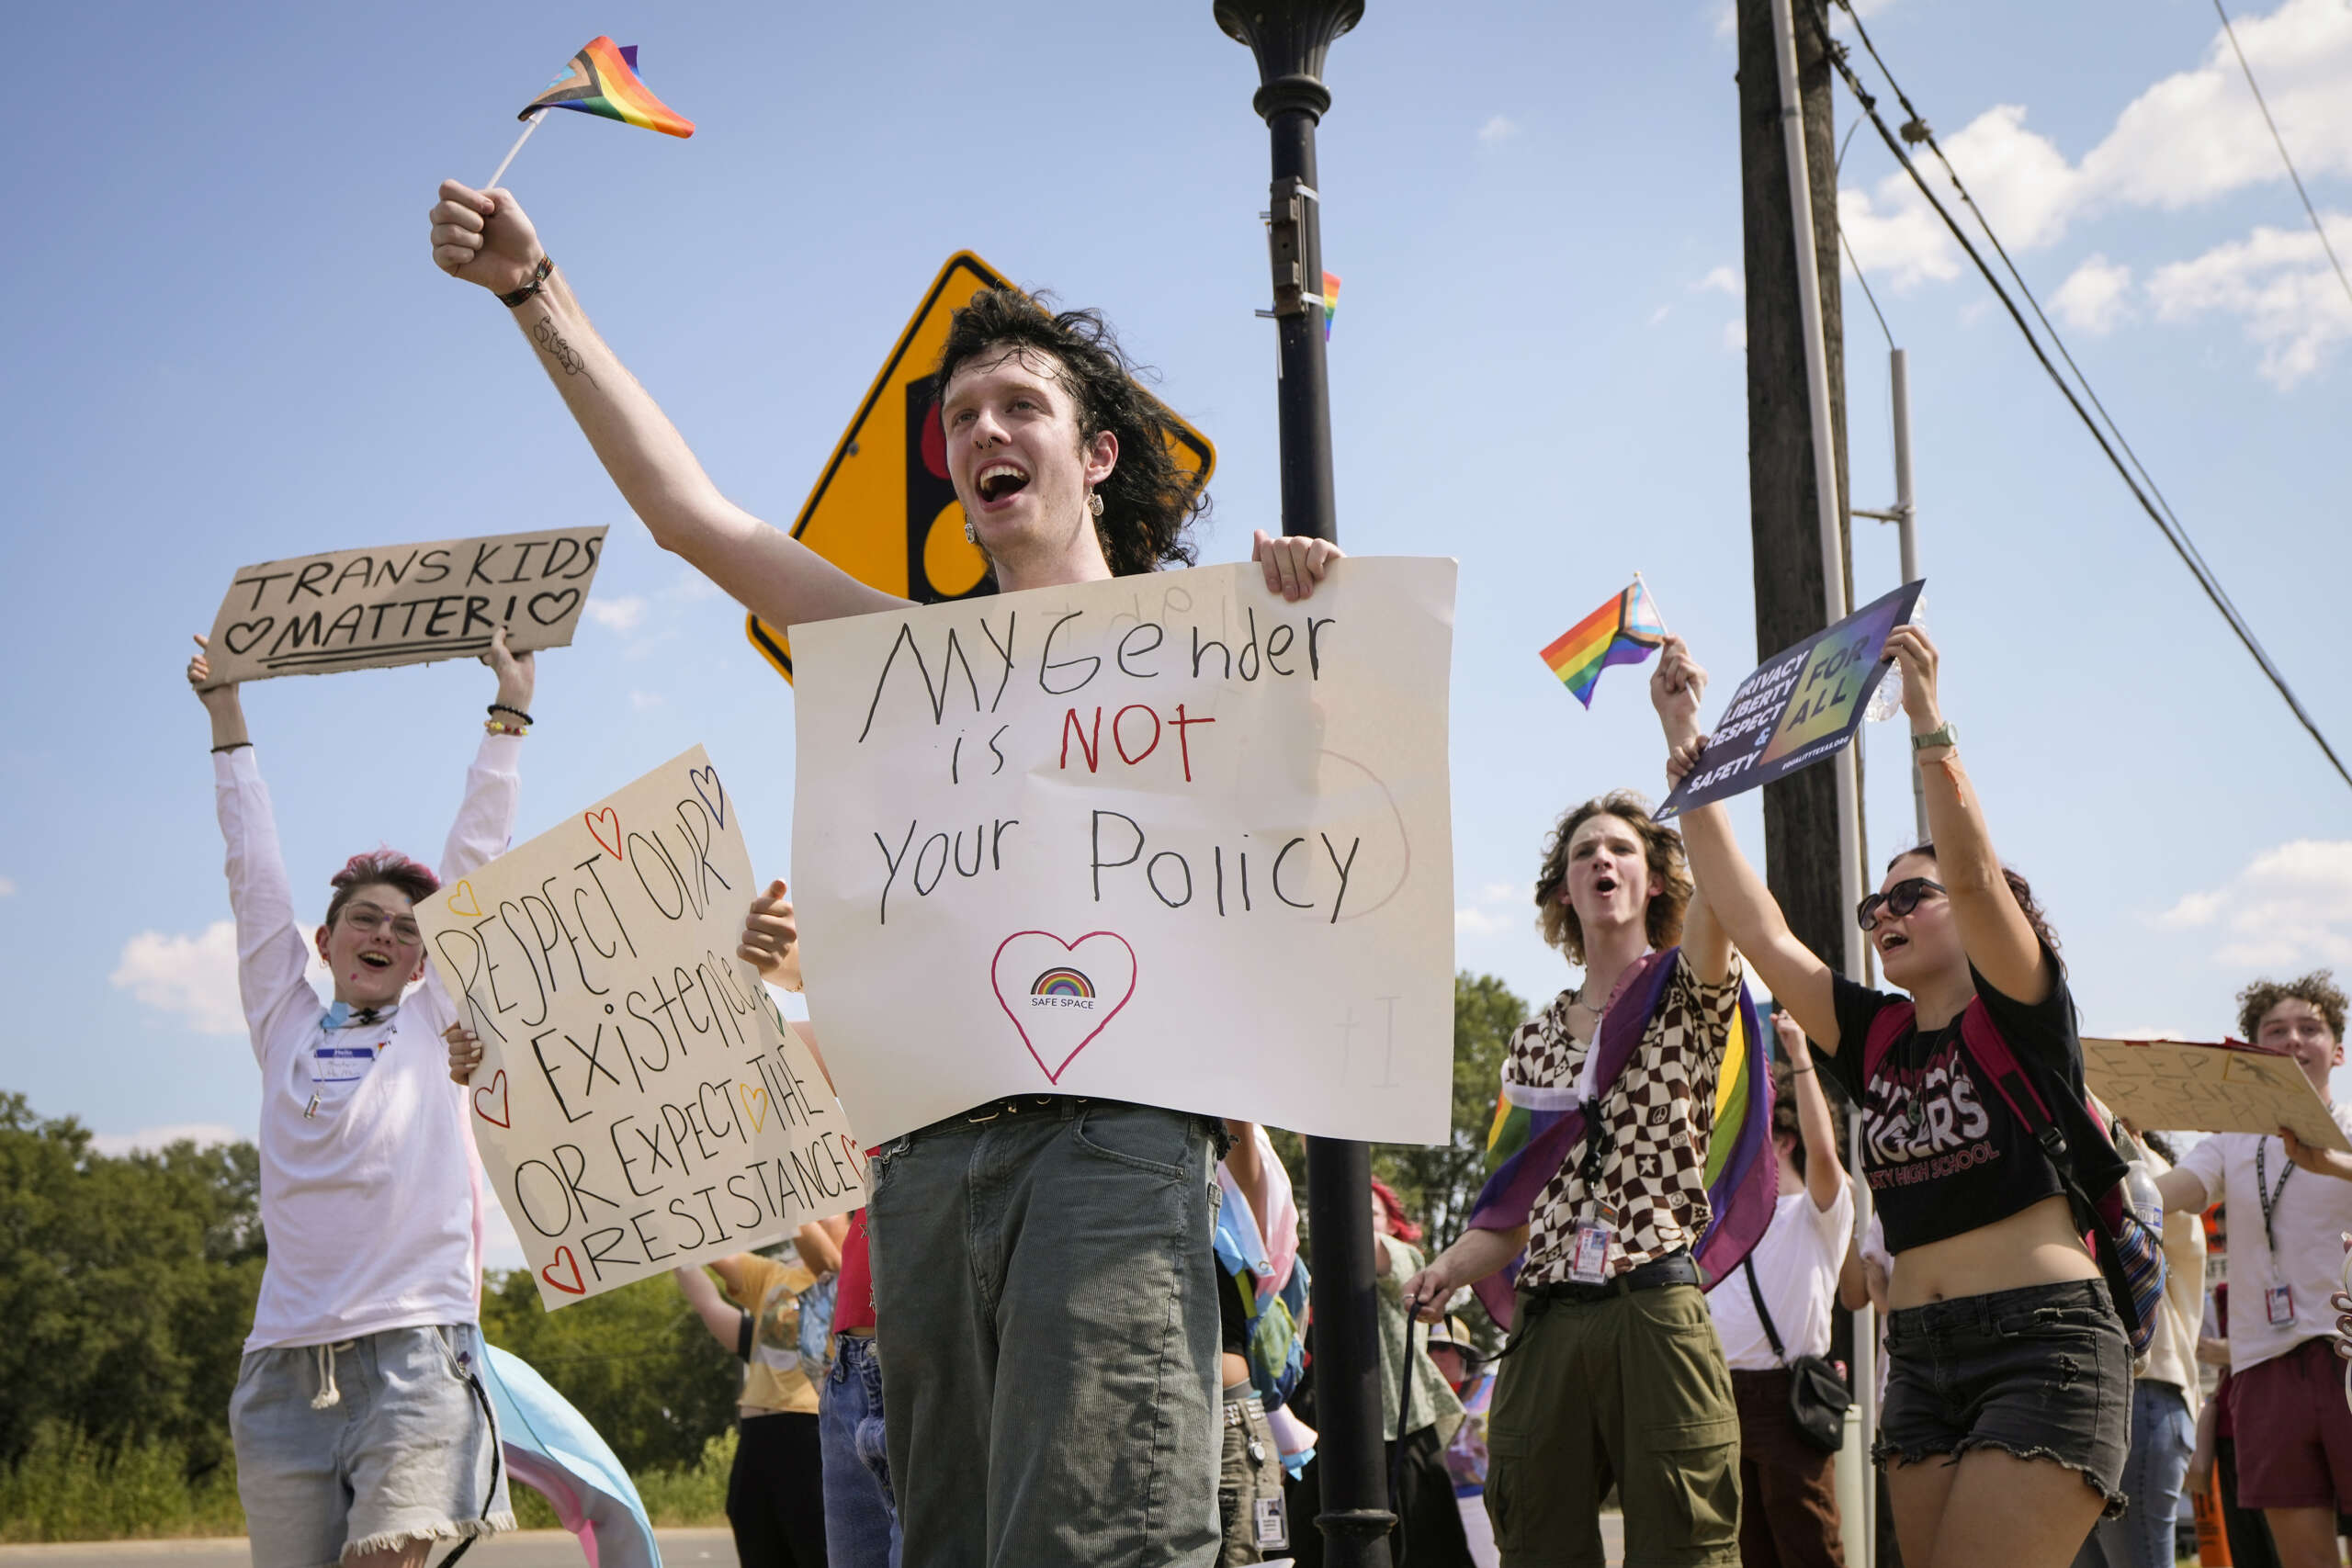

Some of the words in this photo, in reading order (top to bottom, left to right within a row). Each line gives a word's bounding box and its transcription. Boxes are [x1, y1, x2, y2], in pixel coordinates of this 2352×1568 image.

[235, 549, 451, 611] TRANS
[465, 536, 603, 587] KIDS
[268, 595, 517, 655] MATTER!
[859, 610, 1014, 742] MY
[1038, 606, 1336, 694] Gender
[1805, 634, 1871, 693] FOR
[1704, 701, 1786, 751] RESPECT
[1722, 674, 1798, 727] LIBERTY
[1786, 676, 1849, 732] ALL
[934, 724, 1009, 784] is
[1754, 727, 1771, 747] &
[1687, 750, 1761, 795] SAFETY
[874, 818, 1019, 924] your
[435, 853, 637, 1043] RESPECT
[628, 799, 730, 920] OUR
[1031, 998, 1058, 1007] SAFE
[1060, 998, 1094, 1010] SPACE
[514, 1144, 620, 1237] OR
[609, 1078, 747, 1197] EXPECT
[745, 1043, 824, 1132] THE
[1895, 1160, 1930, 1186] HIGH
[1931, 1141, 2000, 1179] SCHOOL
[581, 1132, 857, 1281] RESISTANCE
